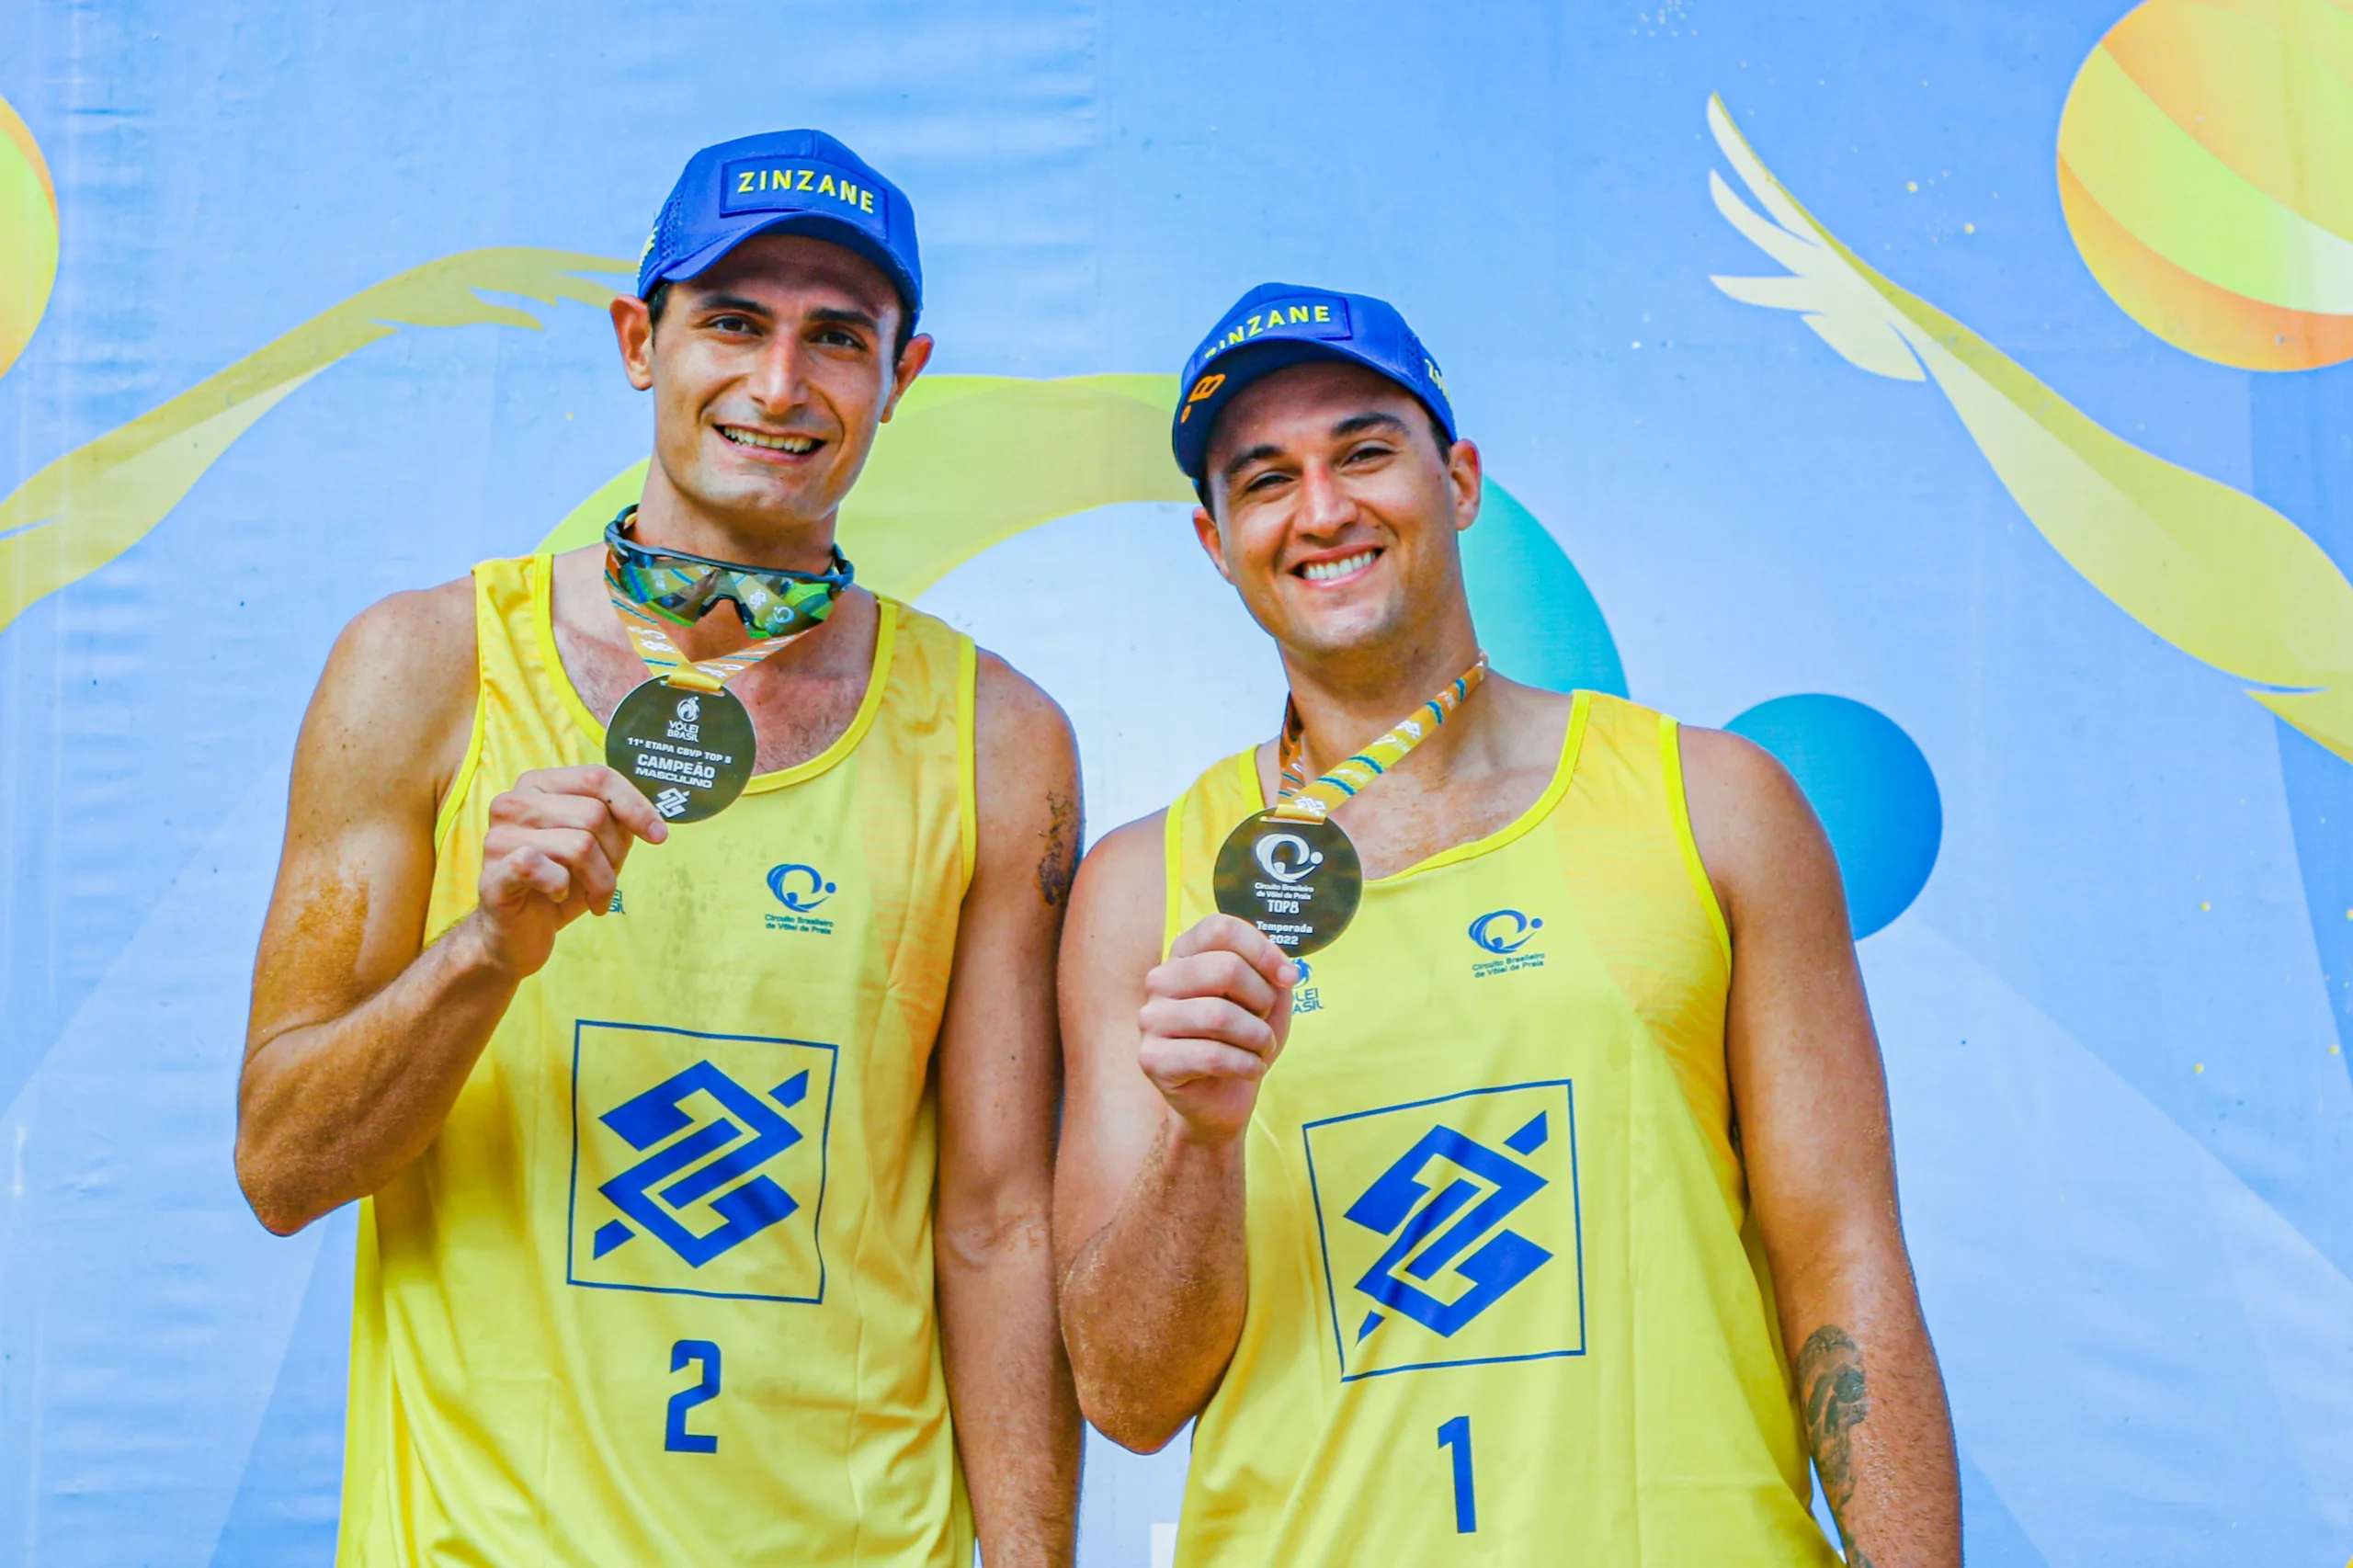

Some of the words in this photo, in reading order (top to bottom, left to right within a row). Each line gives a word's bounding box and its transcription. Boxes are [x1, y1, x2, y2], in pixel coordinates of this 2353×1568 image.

[737, 169, 874, 214] ZINZANE
[667, 729, 699, 742] BRASIL
[645, 742, 674, 753] ETAPA
[677, 747, 702, 757] CBVP
[704, 751, 722, 762] TOP
[637, 753, 716, 779] CAMPEÃO
[635, 767, 713, 790] MASCULINO
[1255, 882, 1281, 891] Circuito
[1282, 883, 1314, 892] Brasileiro
[1267, 900, 1300, 914] TOP8
[766, 914, 795, 922] Circuito
[798, 917, 834, 926] Brasileiro
[1256, 921, 1313, 933] Temporada
[812, 926, 831, 935] Praia
[1268, 935, 1299, 945] 2022
[1472, 960, 1504, 971] Circuito
[1506, 952, 1545, 964] Brasileiro
[1292, 987, 1319, 1002] LEI
[665, 1339, 722, 1454] 2
[1438, 1415, 1476, 1534] 1
